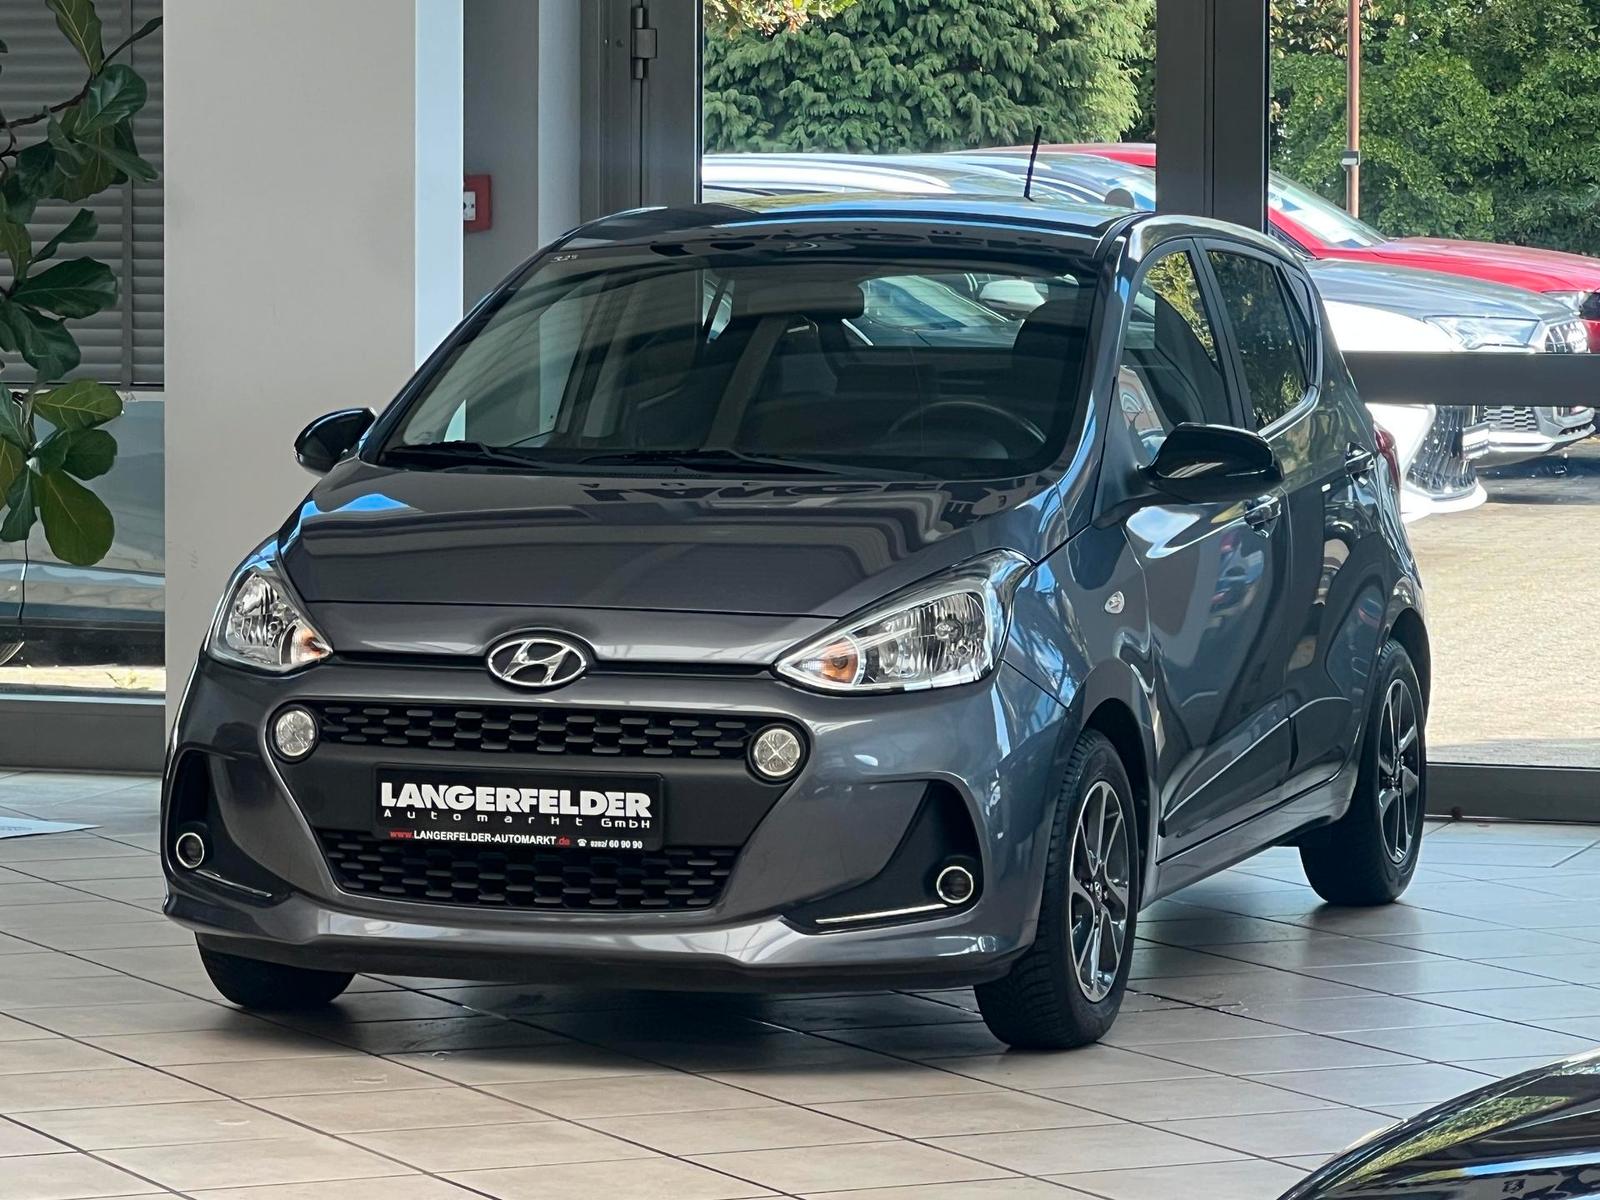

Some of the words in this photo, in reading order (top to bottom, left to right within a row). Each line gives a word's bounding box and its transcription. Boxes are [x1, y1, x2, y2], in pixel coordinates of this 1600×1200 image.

[381, 782, 652, 817] LANGERFELDER
[601, 818, 650, 829] GmbH
[609, 840, 619, 848] 60
[620, 840, 631, 848] 90
[632, 840, 643, 849] 90
